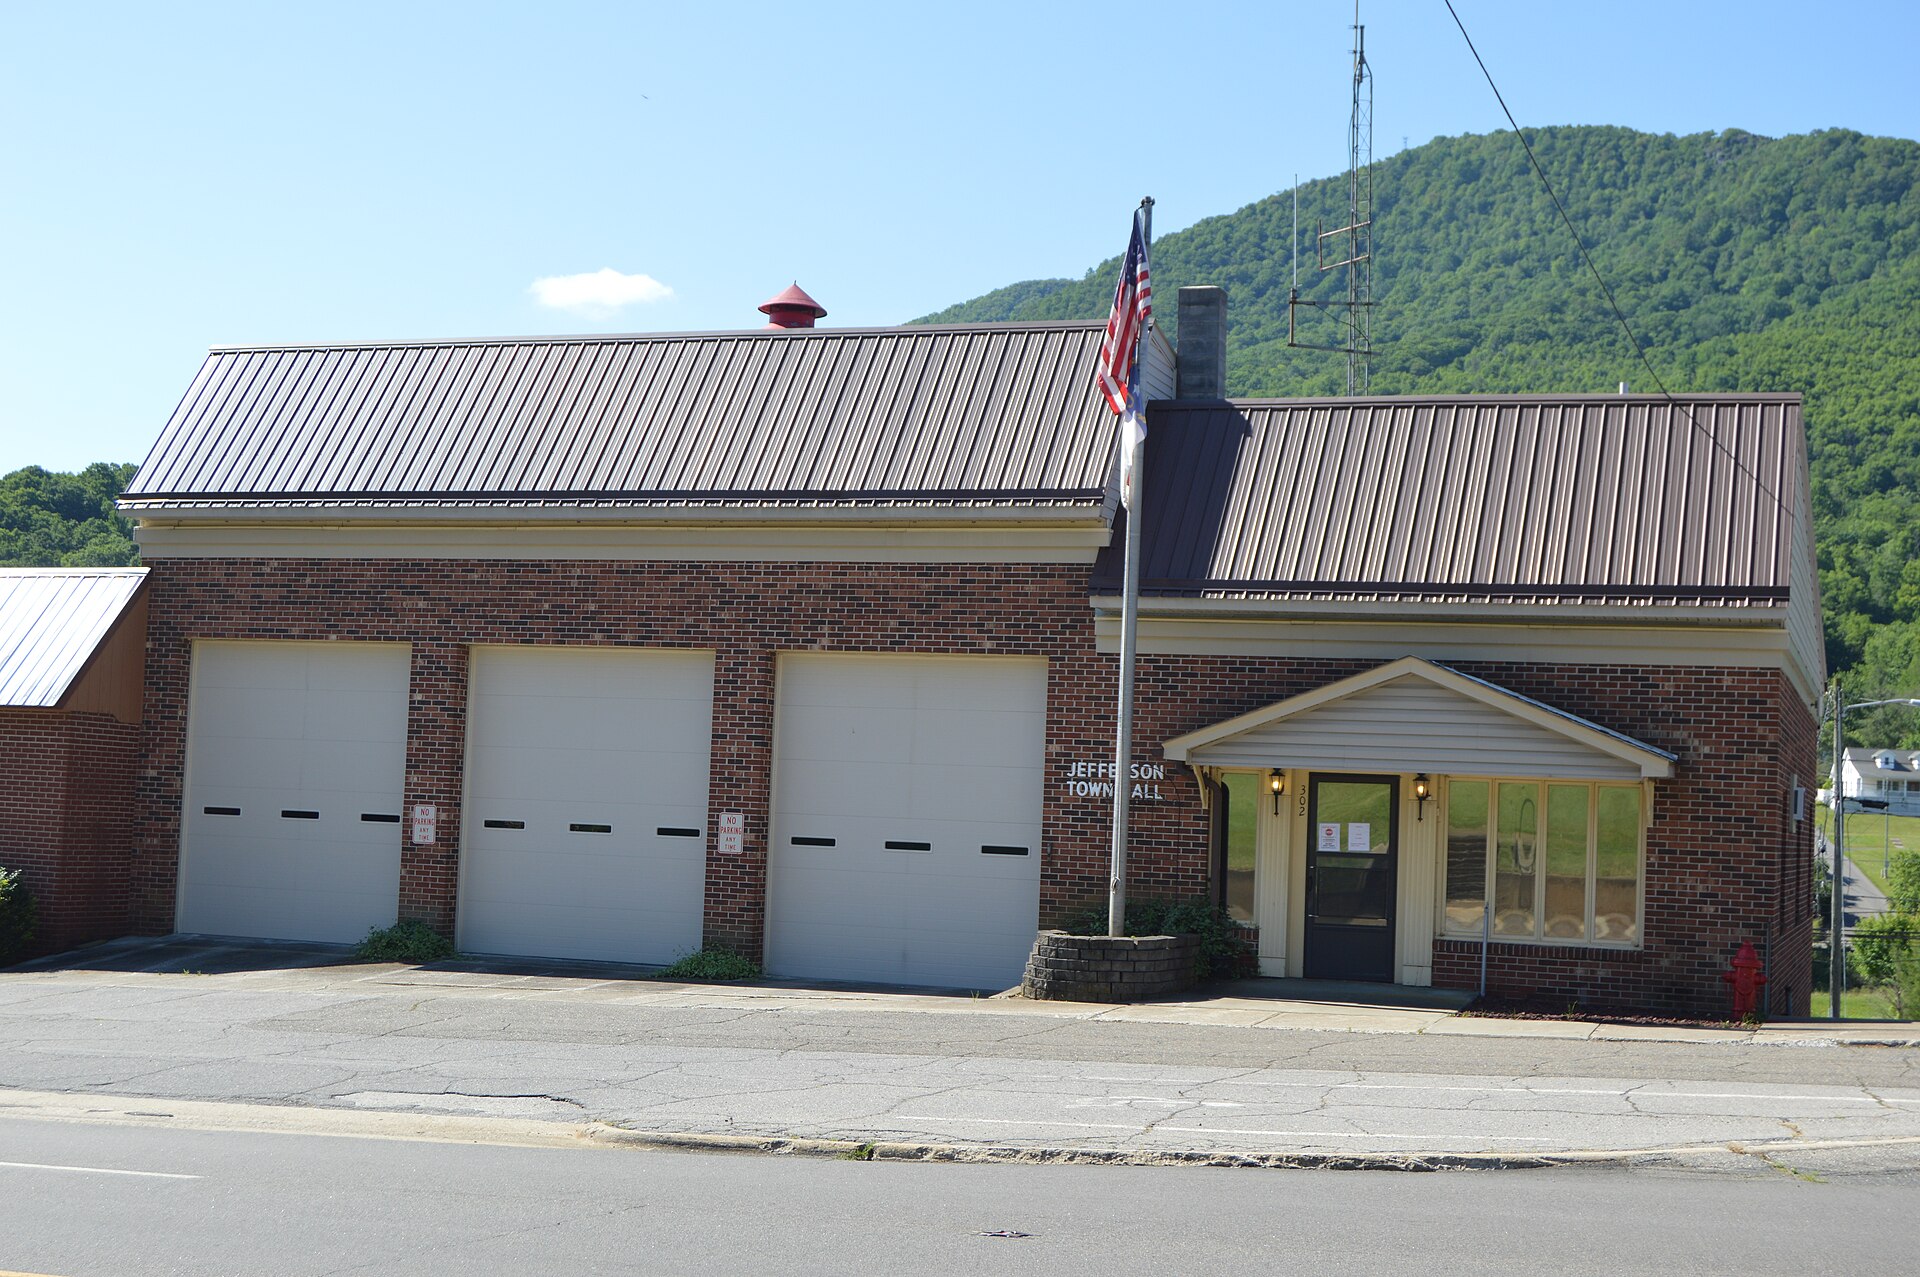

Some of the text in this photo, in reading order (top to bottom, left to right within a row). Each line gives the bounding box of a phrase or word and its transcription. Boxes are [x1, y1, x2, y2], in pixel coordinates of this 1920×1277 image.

[1066, 762, 1164, 780] JEFFESON
[1066, 781, 1163, 800] TOWN ALL
[1298, 784, 1306, 817] 302
[420, 808, 429, 816] NO
[415, 817, 435, 826] PARKING
[720, 826, 742, 835] PARKING
